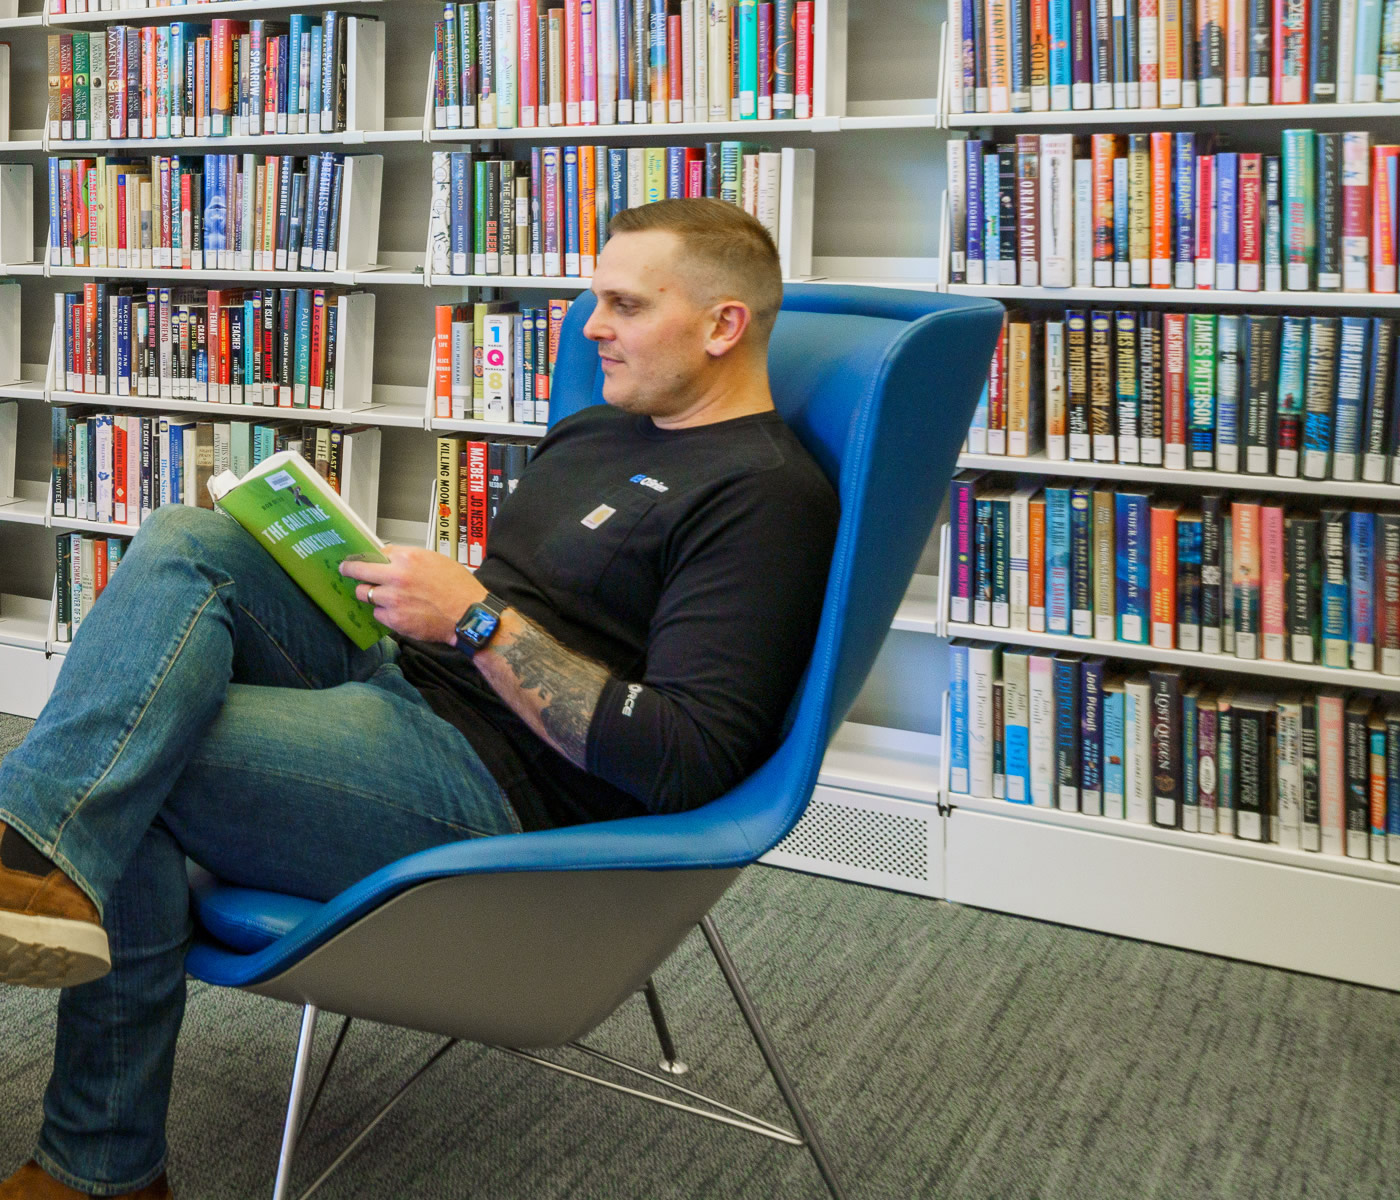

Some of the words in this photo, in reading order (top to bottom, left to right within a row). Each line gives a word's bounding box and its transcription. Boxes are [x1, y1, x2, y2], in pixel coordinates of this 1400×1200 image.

[522, 6, 531, 26] Liane
[108, 31, 117, 78] MARTIN
[250, 31, 260, 49] RED
[522, 28, 531, 61] Moriarty
[250, 51, 260, 96] SPARROW
[445, 33, 457, 100] BEWITCHING
[989, 44, 1007, 86] HIMSEL
[671, 155, 679, 173] JOJO
[723, 147, 738, 182] HUNTED
[969, 163, 978, 190] KEEPER
[1135, 155, 1144, 187] BRING
[318, 161, 331, 211] BREATHLESS
[503, 181, 511, 197] THE
[546, 176, 554, 198] KATE
[671, 175, 679, 199] MOYES
[1020, 181, 1035, 219] ORHAN
[1135, 191, 1144, 203] ME
[1156, 163, 1166, 227] BREAKDOWN
[503, 200, 511, 223] RIGHT
[546, 202, 554, 233] MOSSE
[969, 201, 978, 231] STORIES
[1135, 209, 1144, 235] BACK
[503, 227, 511, 255] MISTAK
[1020, 225, 1035, 262] PAMUK
[161, 307, 169, 341] BOYFRIEND
[210, 312, 218, 336] TENANT
[232, 322, 240, 350] TEACHER
[300, 308, 308, 340] PAULA
[490, 326, 500, 343] 1
[1167, 320, 1184, 340] JAMES
[1194, 320, 1213, 356] JAMES
[1283, 322, 1303, 347] JAMES
[1222, 328, 1238, 353] JAMES
[1310, 324, 1335, 356] JAMES
[300, 345, 308, 382] McLAIN
[487, 349, 505, 366] Q
[1070, 346, 1086, 393] PATTERSON
[1167, 340, 1184, 373] PATTERSON
[1283, 349, 1303, 391] PATTERSON
[488, 372, 504, 390] 8
[1091, 345, 1109, 406] PATTERSON
[1222, 354, 1238, 396] PATTERSON
[1307, 359, 1332, 412] PATTERSON
[1194, 360, 1213, 425] PATTERSON
[317, 439, 327, 460] THE
[439, 443, 450, 477] KILLING
[470, 447, 484, 493] MACBETH
[439, 479, 450, 506] MOON
[470, 495, 484, 508] JO
[261, 521, 290, 545] THE
[281, 512, 308, 532] CALL
[306, 504, 331, 522] THE
[439, 516, 450, 528] JO
[1128, 504, 1138, 536] UNDER
[1240, 511, 1251, 538] HAPPY
[110, 547, 118, 559] SUE
[291, 529, 347, 559] HONEYGUIDE
[1296, 539, 1307, 569] ESSEX
[1326, 523, 1344, 556] THOMAS
[1128, 549, 1138, 571] POLE
[1326, 559, 1344, 585] PERRY
[1128, 573, 1138, 599] STAR
[1296, 572, 1307, 620] SERPENT
[1058, 665, 1074, 693] JODI
[1086, 671, 1099, 693] Jodi
[1058, 696, 1074, 748] PICOULT
[1086, 696, 1099, 731] Picoult
[1155, 693, 1171, 723] LOST
[1155, 724, 1171, 771] QUEEN
